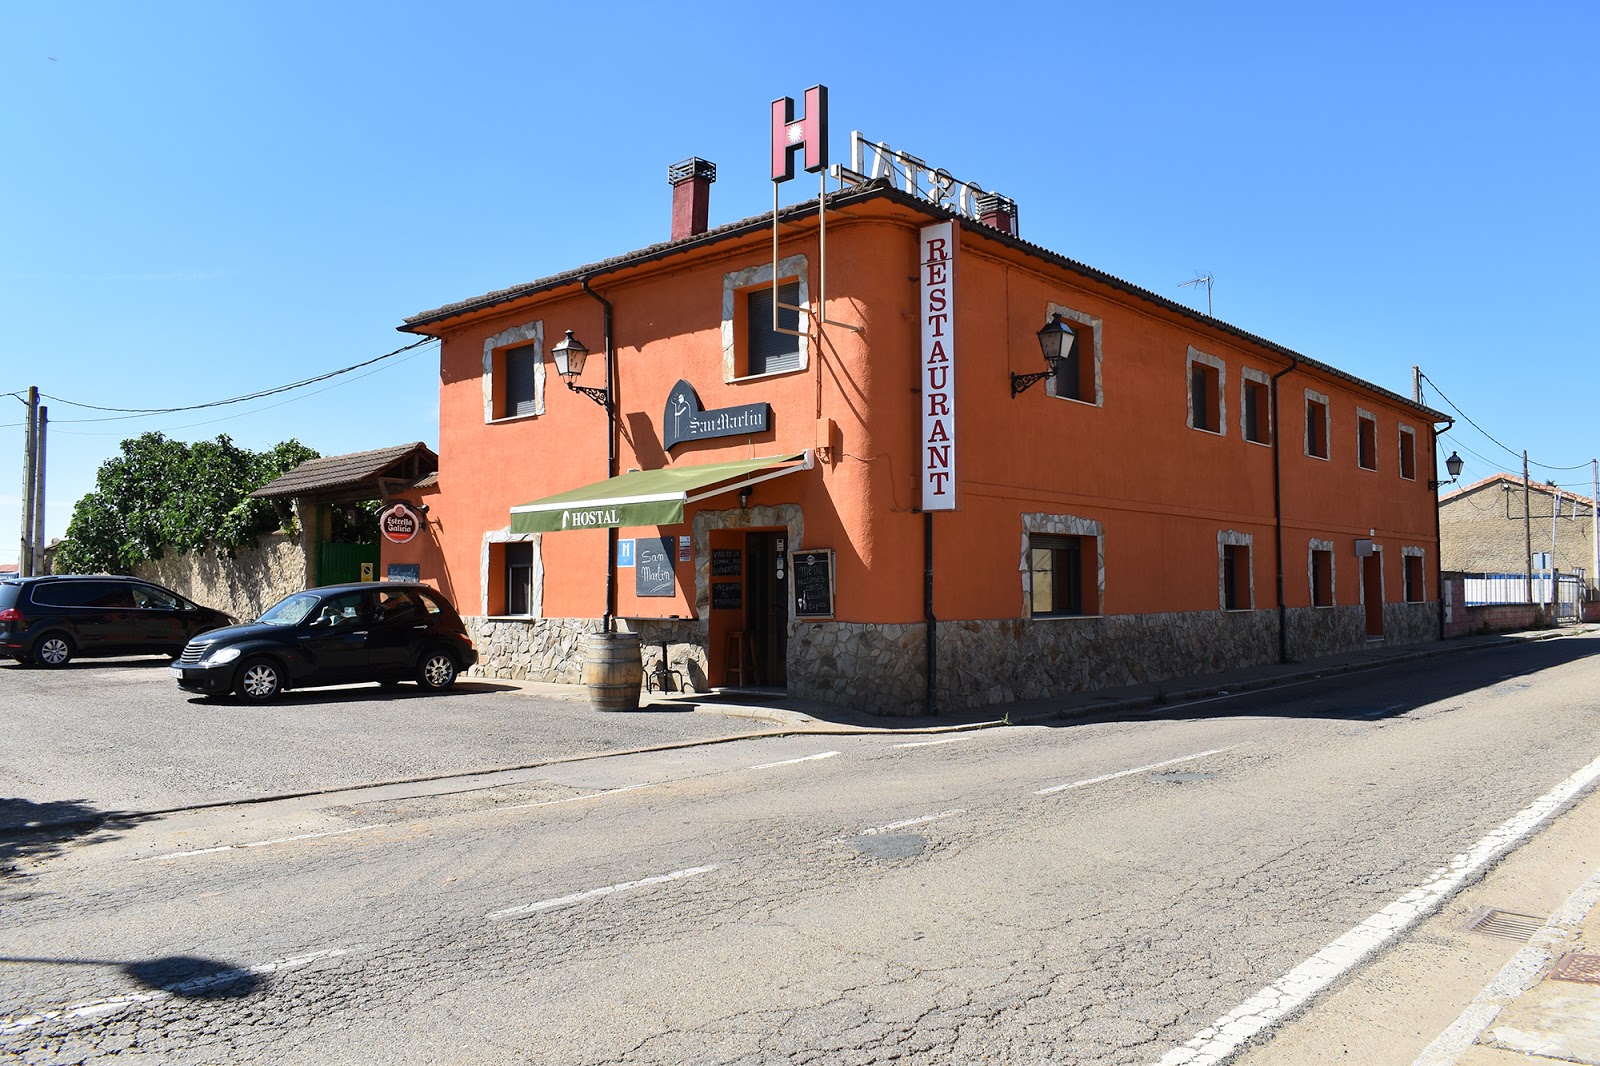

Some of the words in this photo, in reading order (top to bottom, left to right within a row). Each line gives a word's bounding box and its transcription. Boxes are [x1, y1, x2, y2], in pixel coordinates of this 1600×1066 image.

[771, 84, 828, 183] H
[926, 238, 950, 496] RESTAURANT
[689, 417, 715, 434] San
[387, 516, 413, 526] Estrella
[572, 509, 620, 527] HOSTAL
[388, 524, 412, 533] Galicia
[622, 542, 631, 557] H
[641, 550, 664, 564] San
[641, 563, 670, 582] Martin
